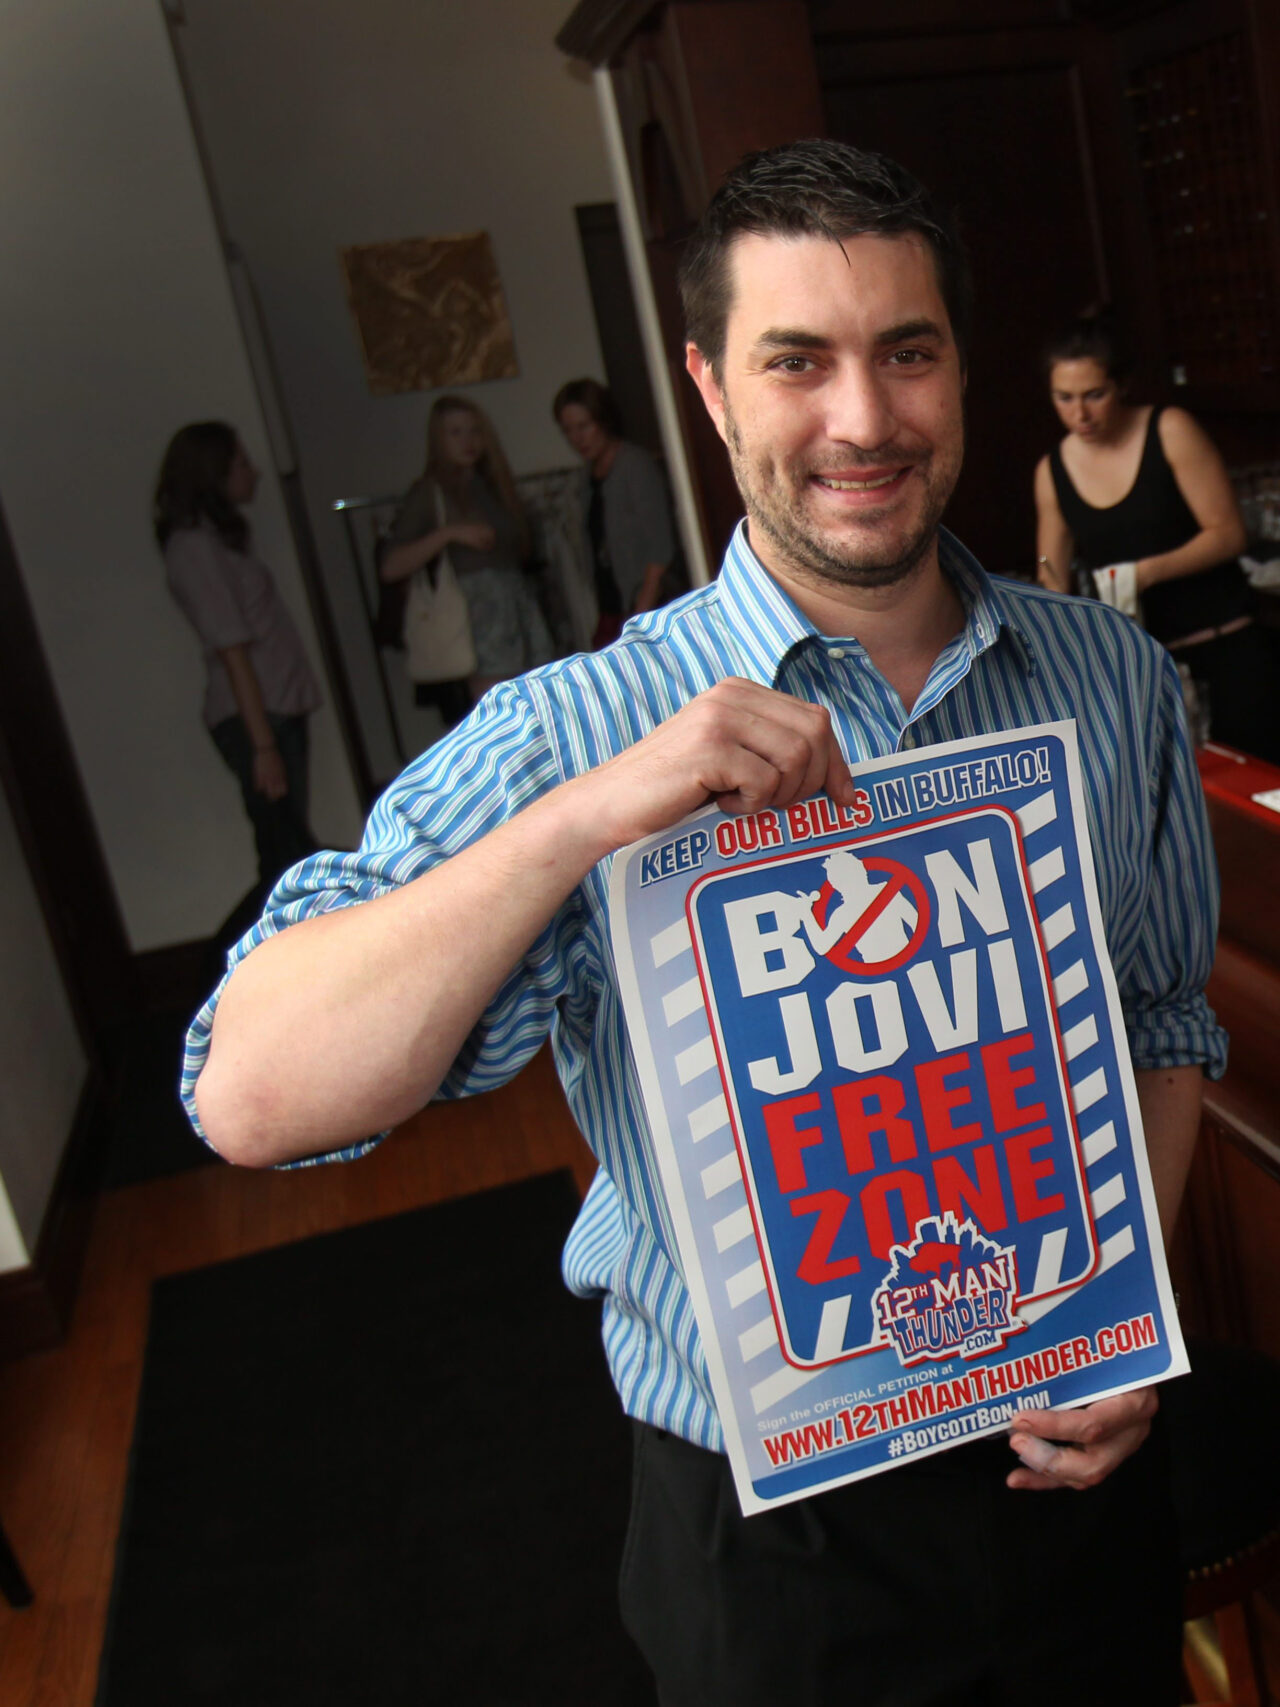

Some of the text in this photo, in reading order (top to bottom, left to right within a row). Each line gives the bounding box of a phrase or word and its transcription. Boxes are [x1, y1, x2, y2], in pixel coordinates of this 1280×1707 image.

[640, 747, 1052, 888] KEEP OUR BILLS IN BUFFALO!
[748, 938, 1028, 1095] JOVI
[761, 1032, 1048, 1195] FREE
[789, 1125, 1066, 1286] ZONE
[879, 1258, 1008, 1325] 12TH MAN
[894, 1288, 1008, 1355] THUNDER
[964, 1330, 997, 1353] .COM
[757, 1364, 954, 1432] Sign the OFFICIAL PETITION at
